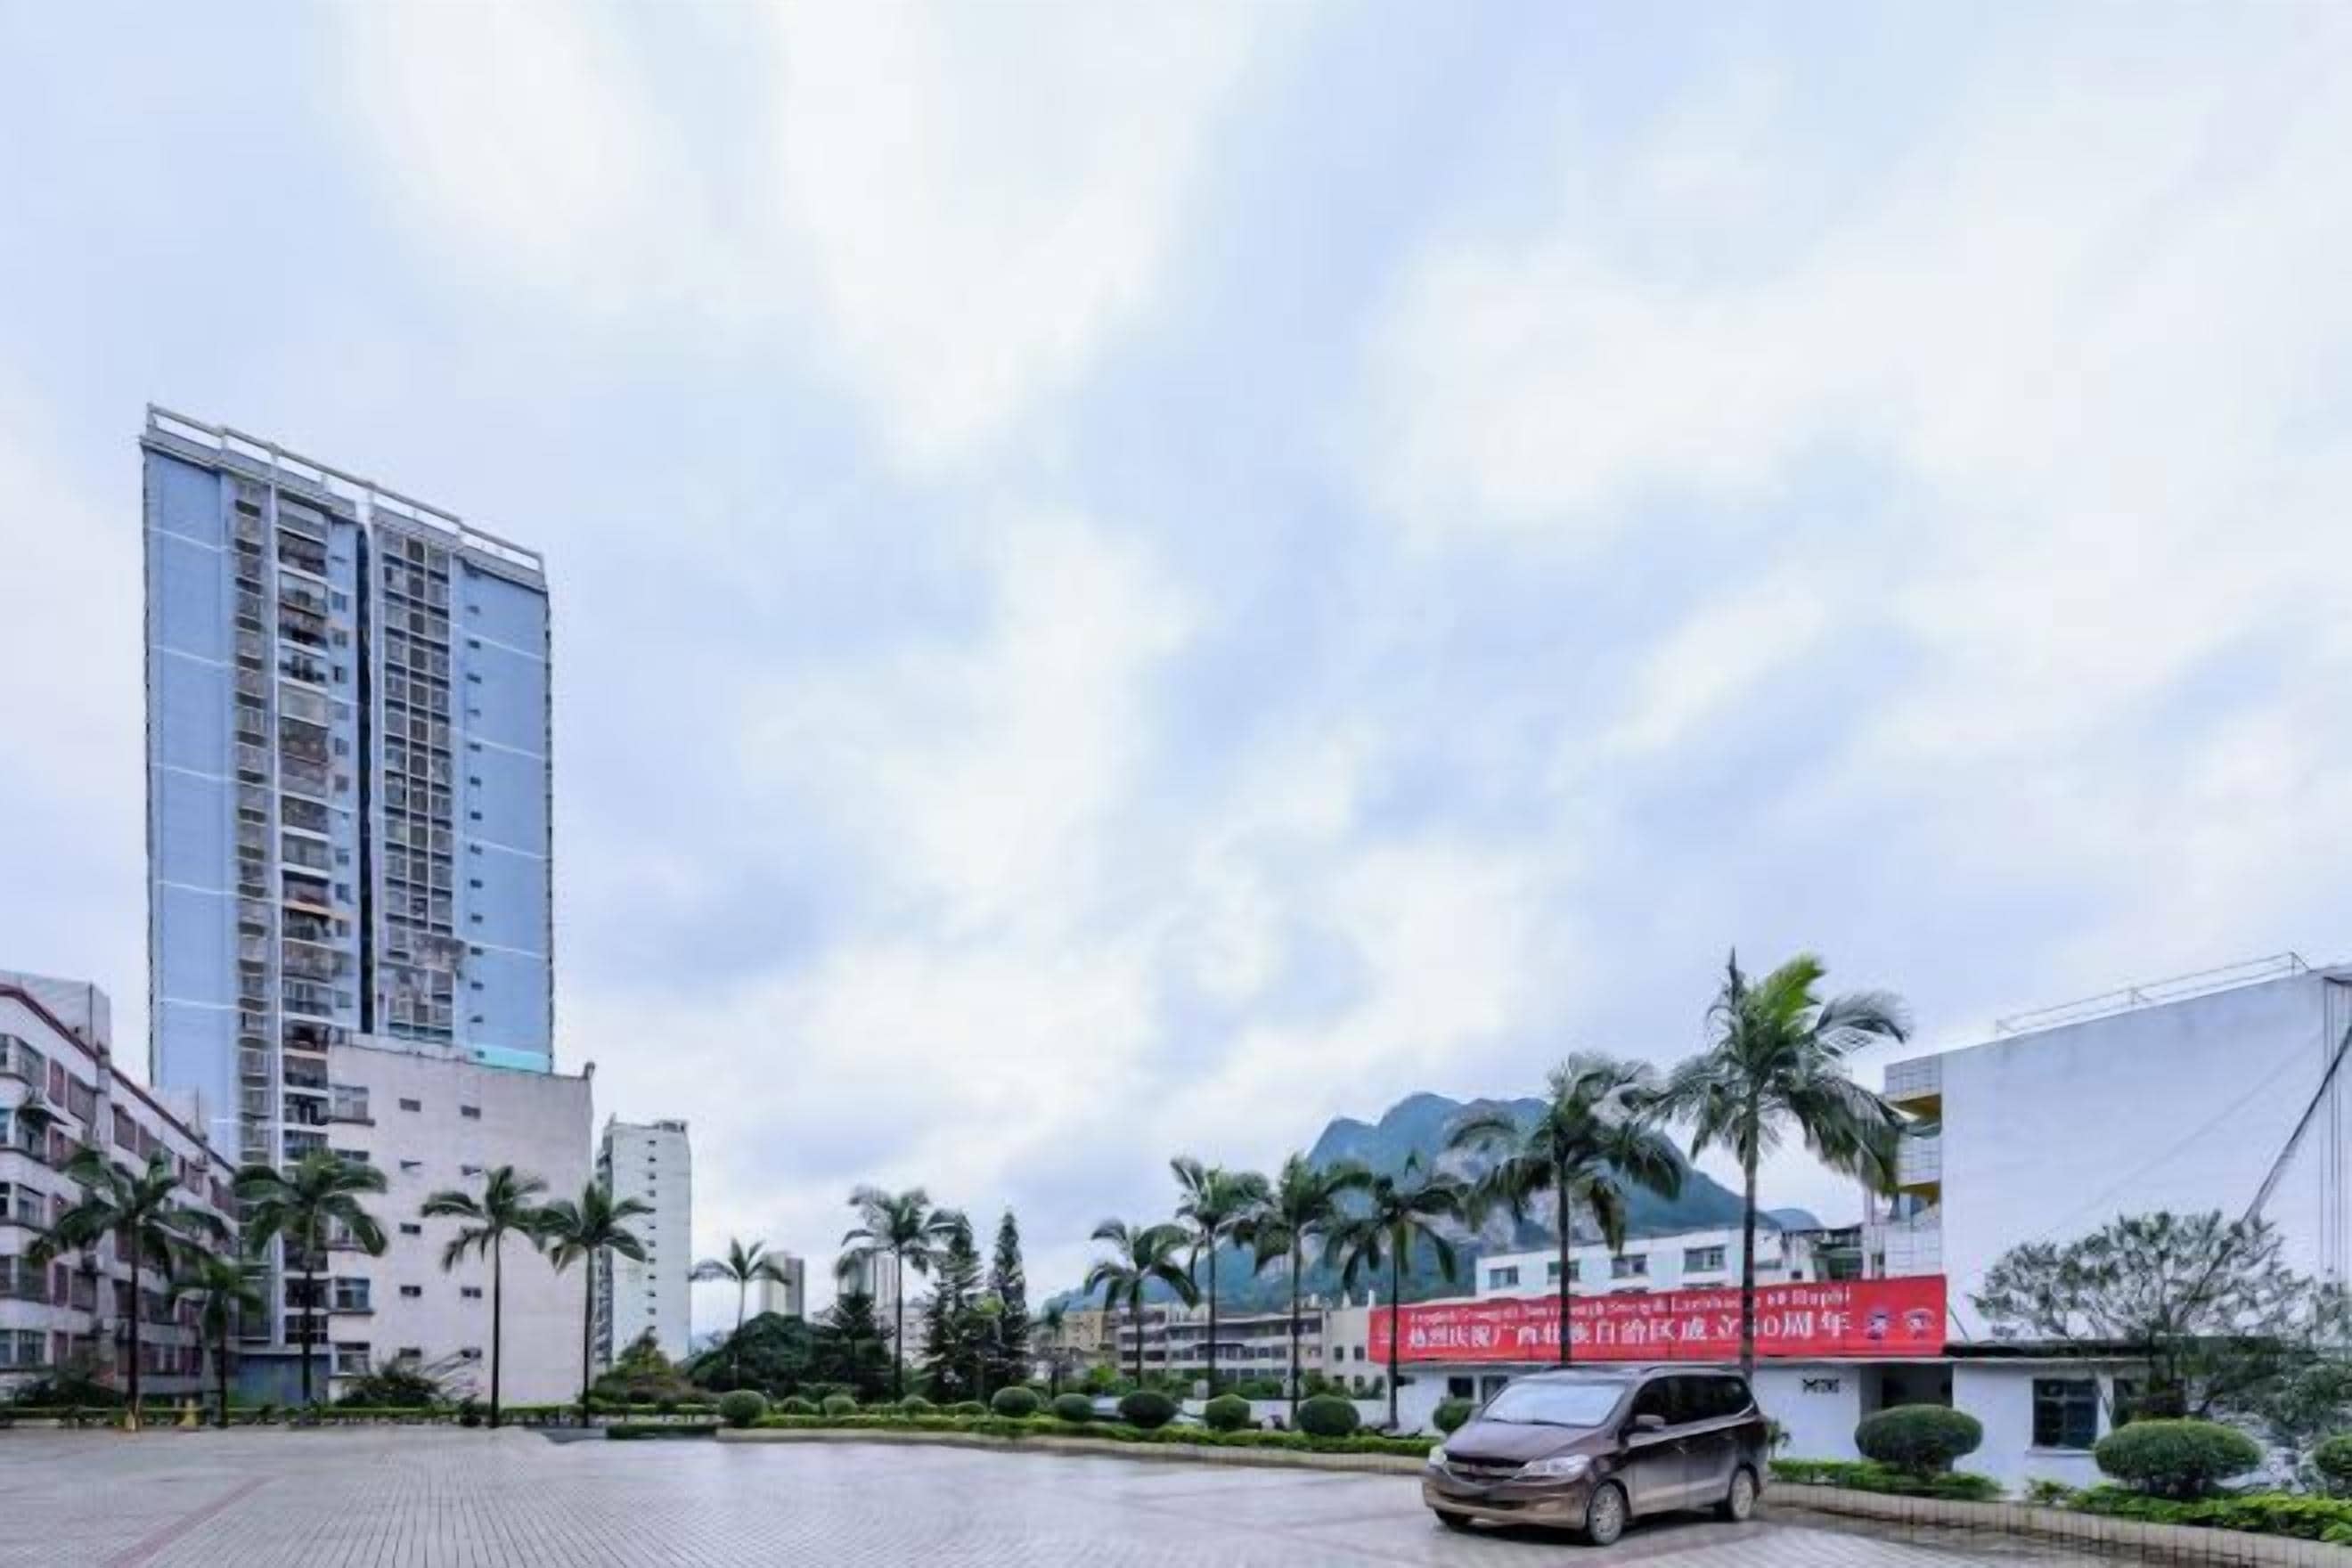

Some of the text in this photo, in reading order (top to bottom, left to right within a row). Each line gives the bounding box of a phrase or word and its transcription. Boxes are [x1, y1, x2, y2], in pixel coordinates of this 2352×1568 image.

[1409, 1310, 1852, 1348] 热烈庆祝广西壮族自治区成立0周年
